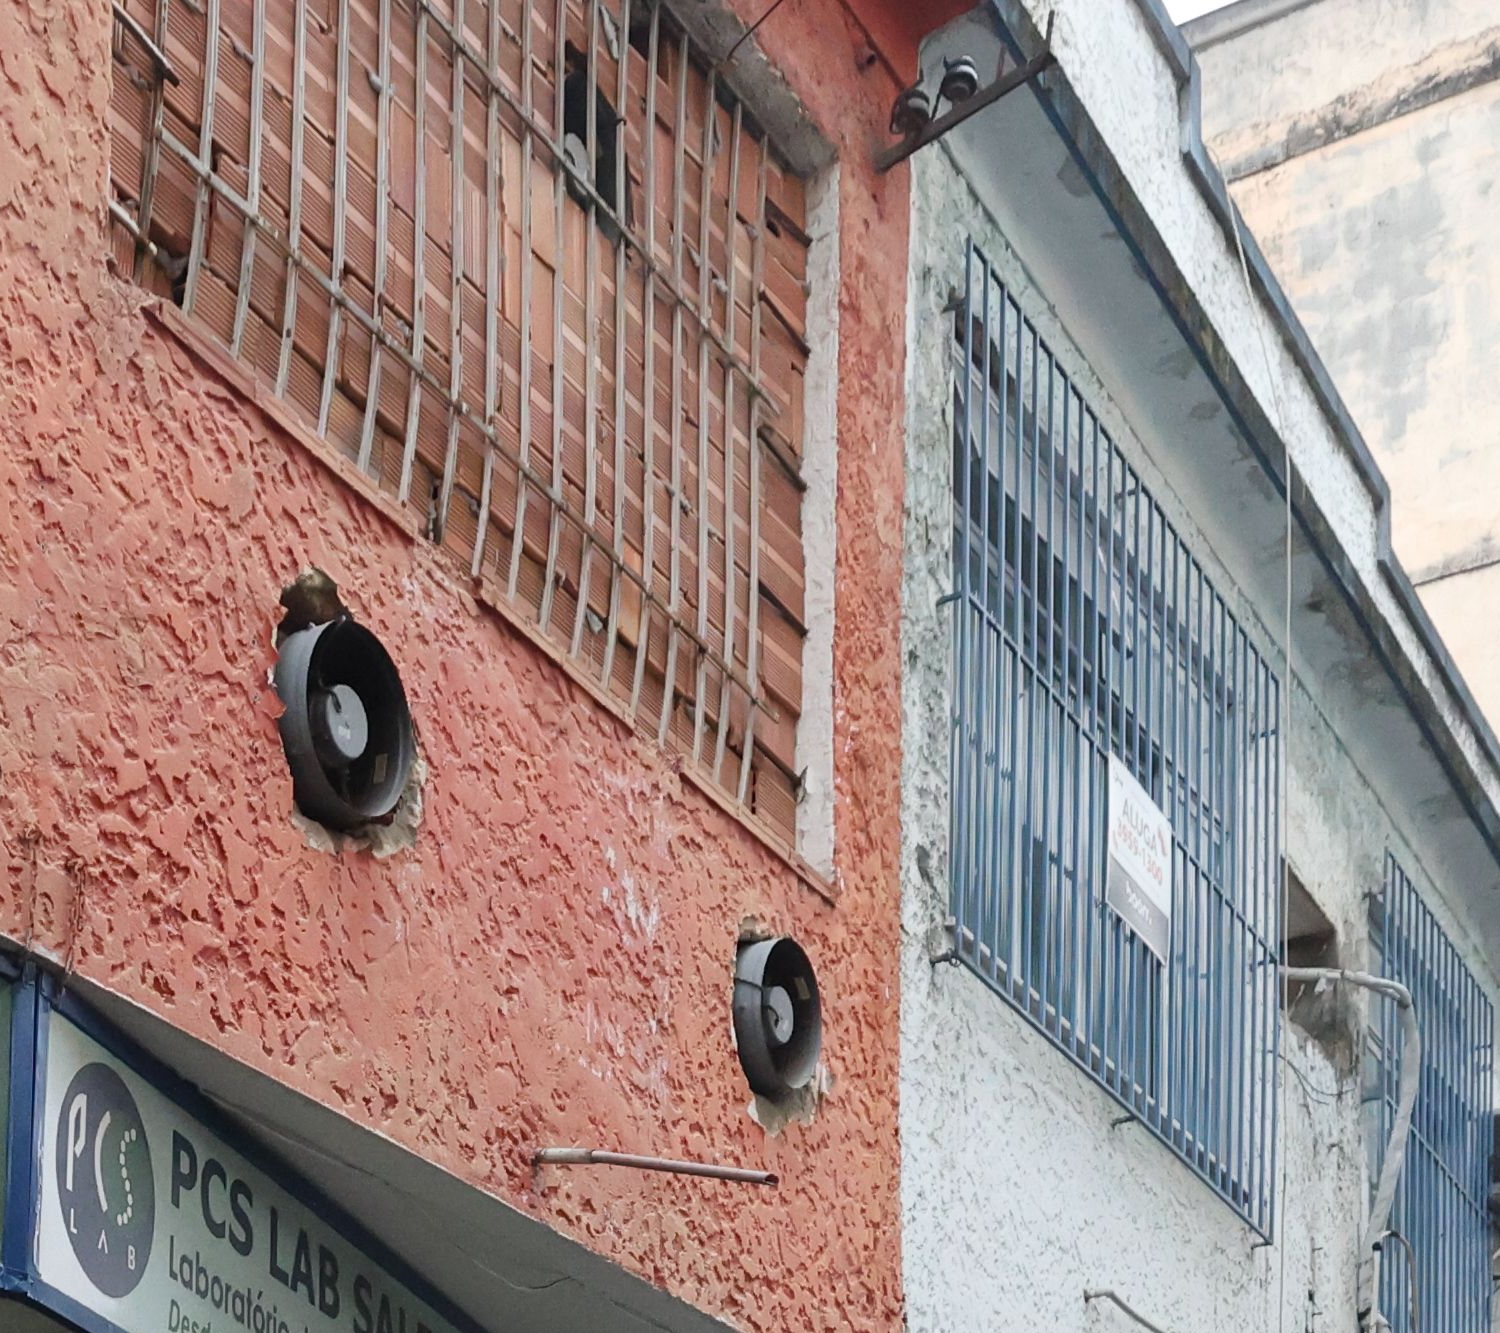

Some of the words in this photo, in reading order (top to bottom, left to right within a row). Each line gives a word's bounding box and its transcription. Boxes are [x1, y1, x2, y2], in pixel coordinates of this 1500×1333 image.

[65, 1092, 137, 1226] PCS
[170, 1129, 254, 1257] PCS
[268, 1206, 340, 1321] LAB
[69, 1206, 137, 1271] LAB
